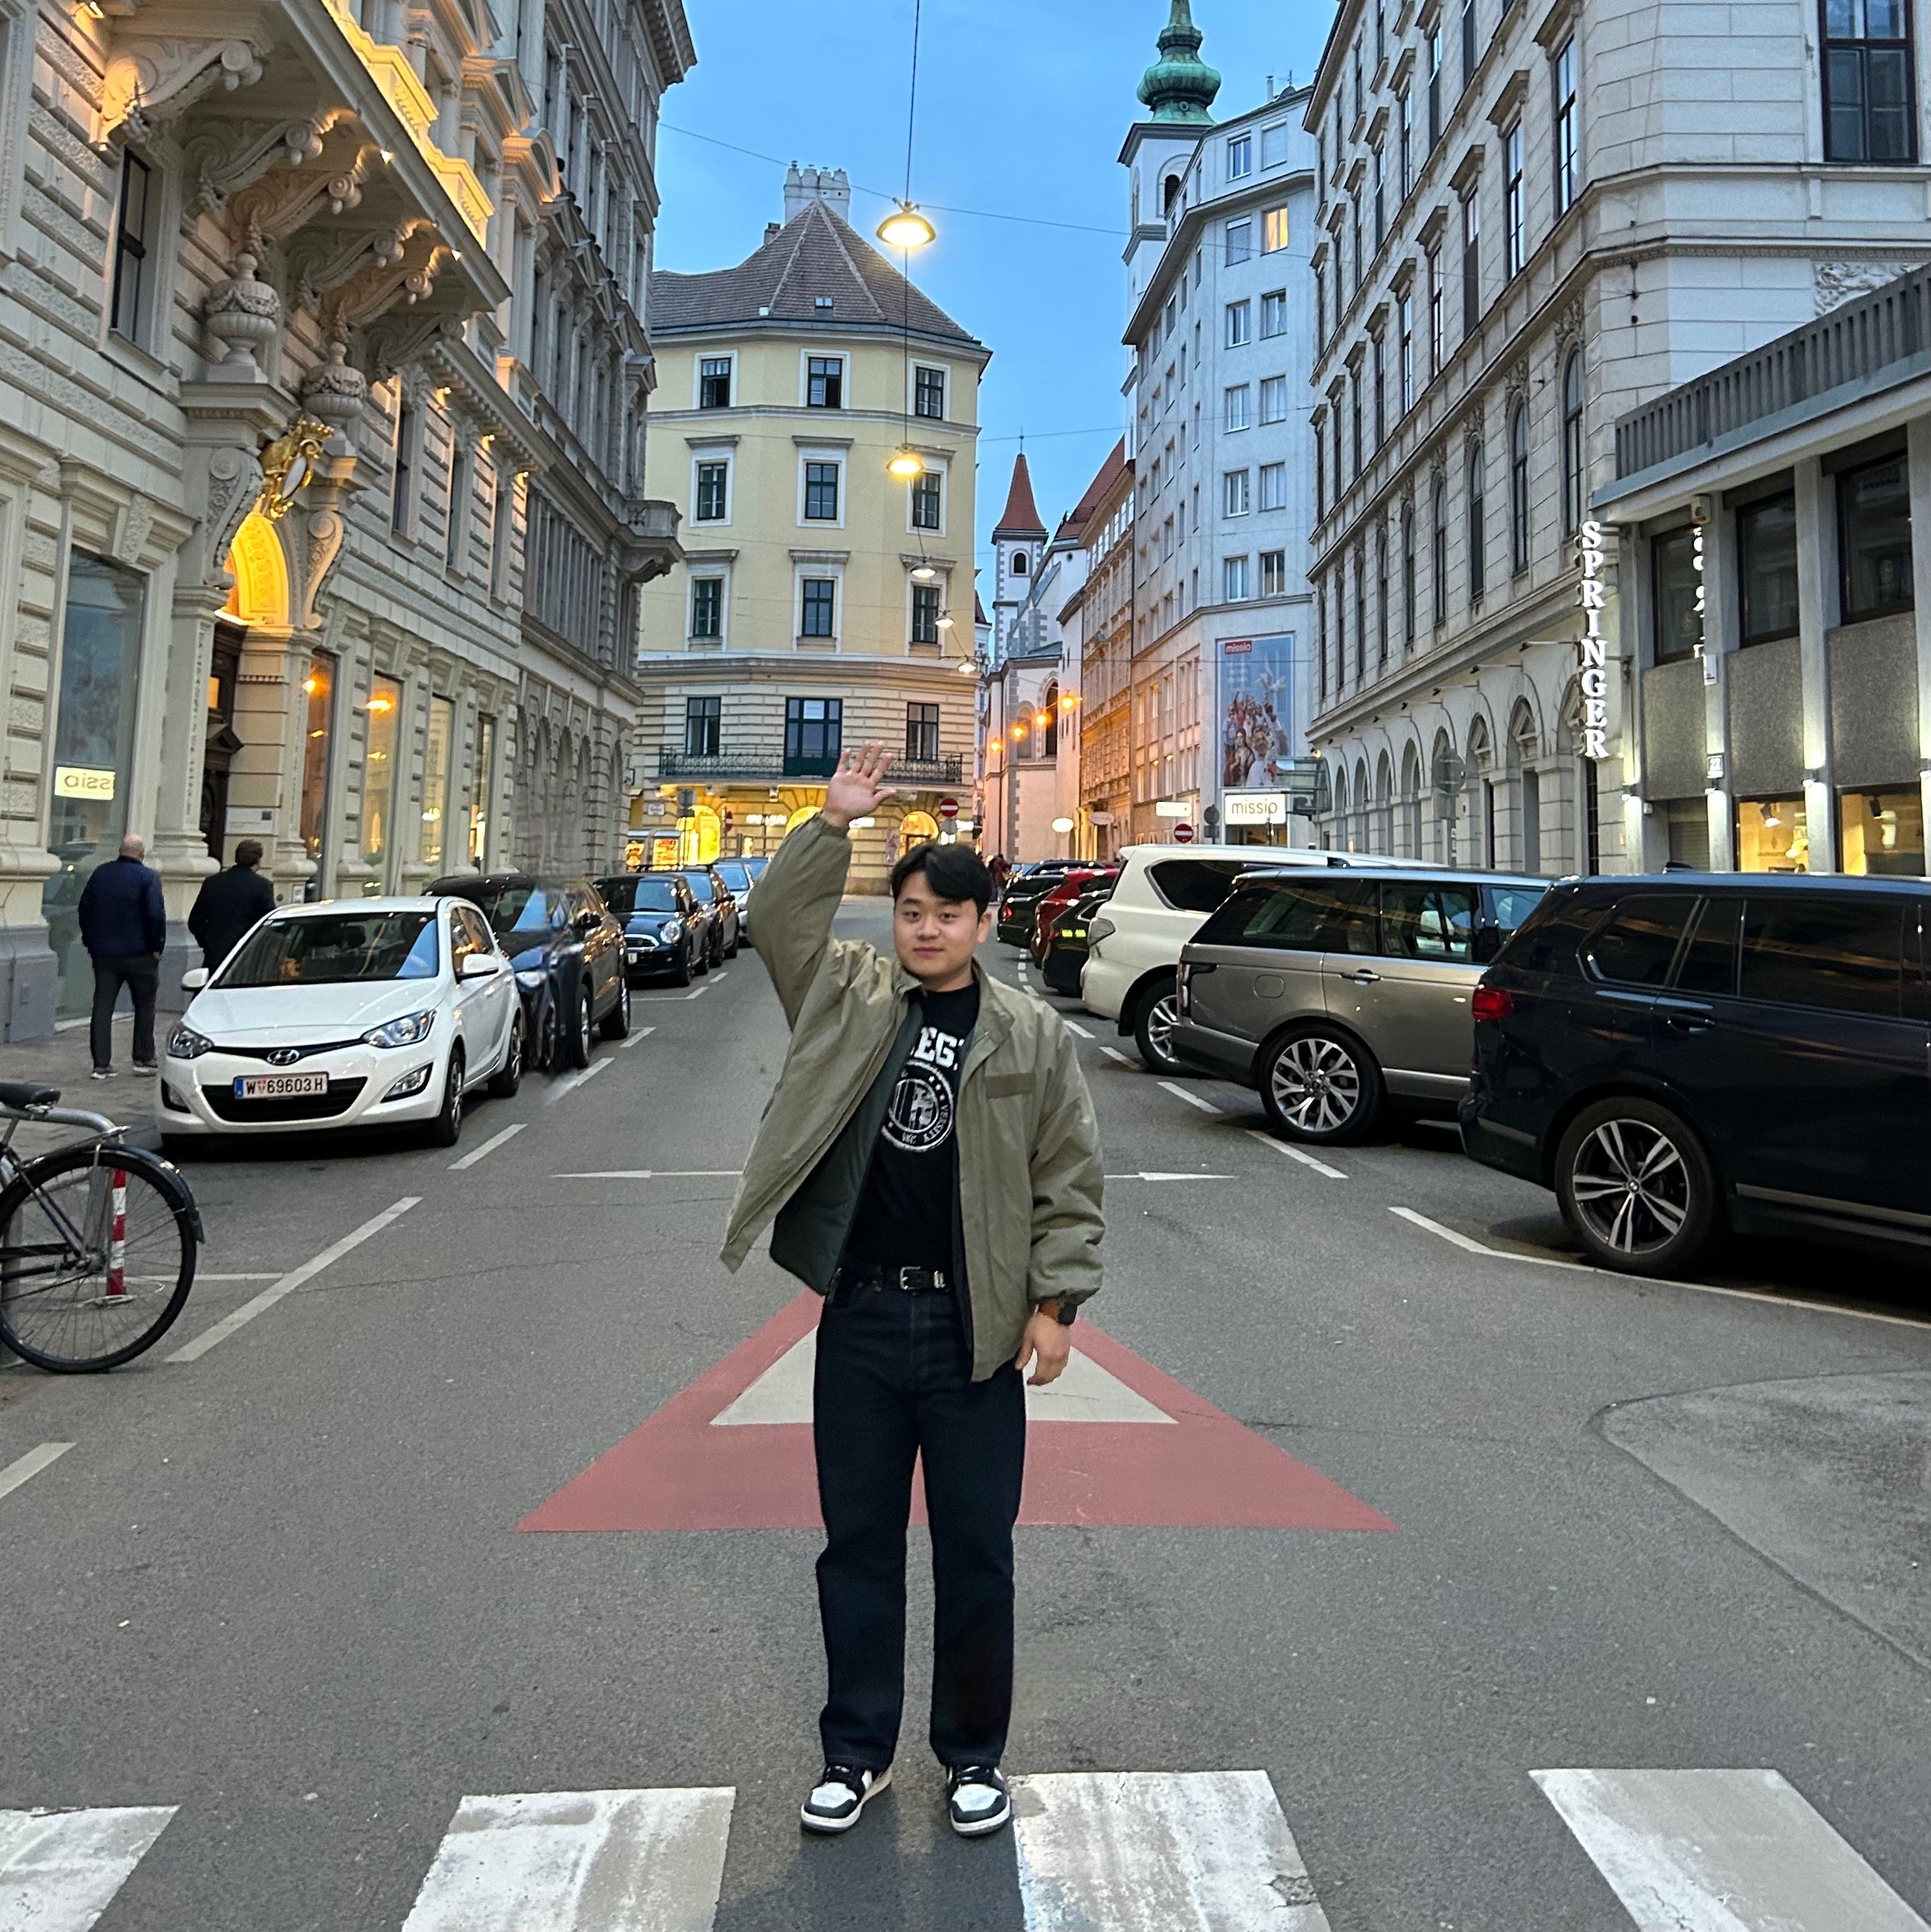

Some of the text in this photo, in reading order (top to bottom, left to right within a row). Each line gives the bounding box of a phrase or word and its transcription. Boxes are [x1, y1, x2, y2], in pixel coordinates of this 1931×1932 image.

[1225, 642, 1251, 653] missio
[1581, 520, 1609, 759] SPRINGER
[1232, 798, 1278, 814] missio
[910, 1026, 964, 1071] EG
